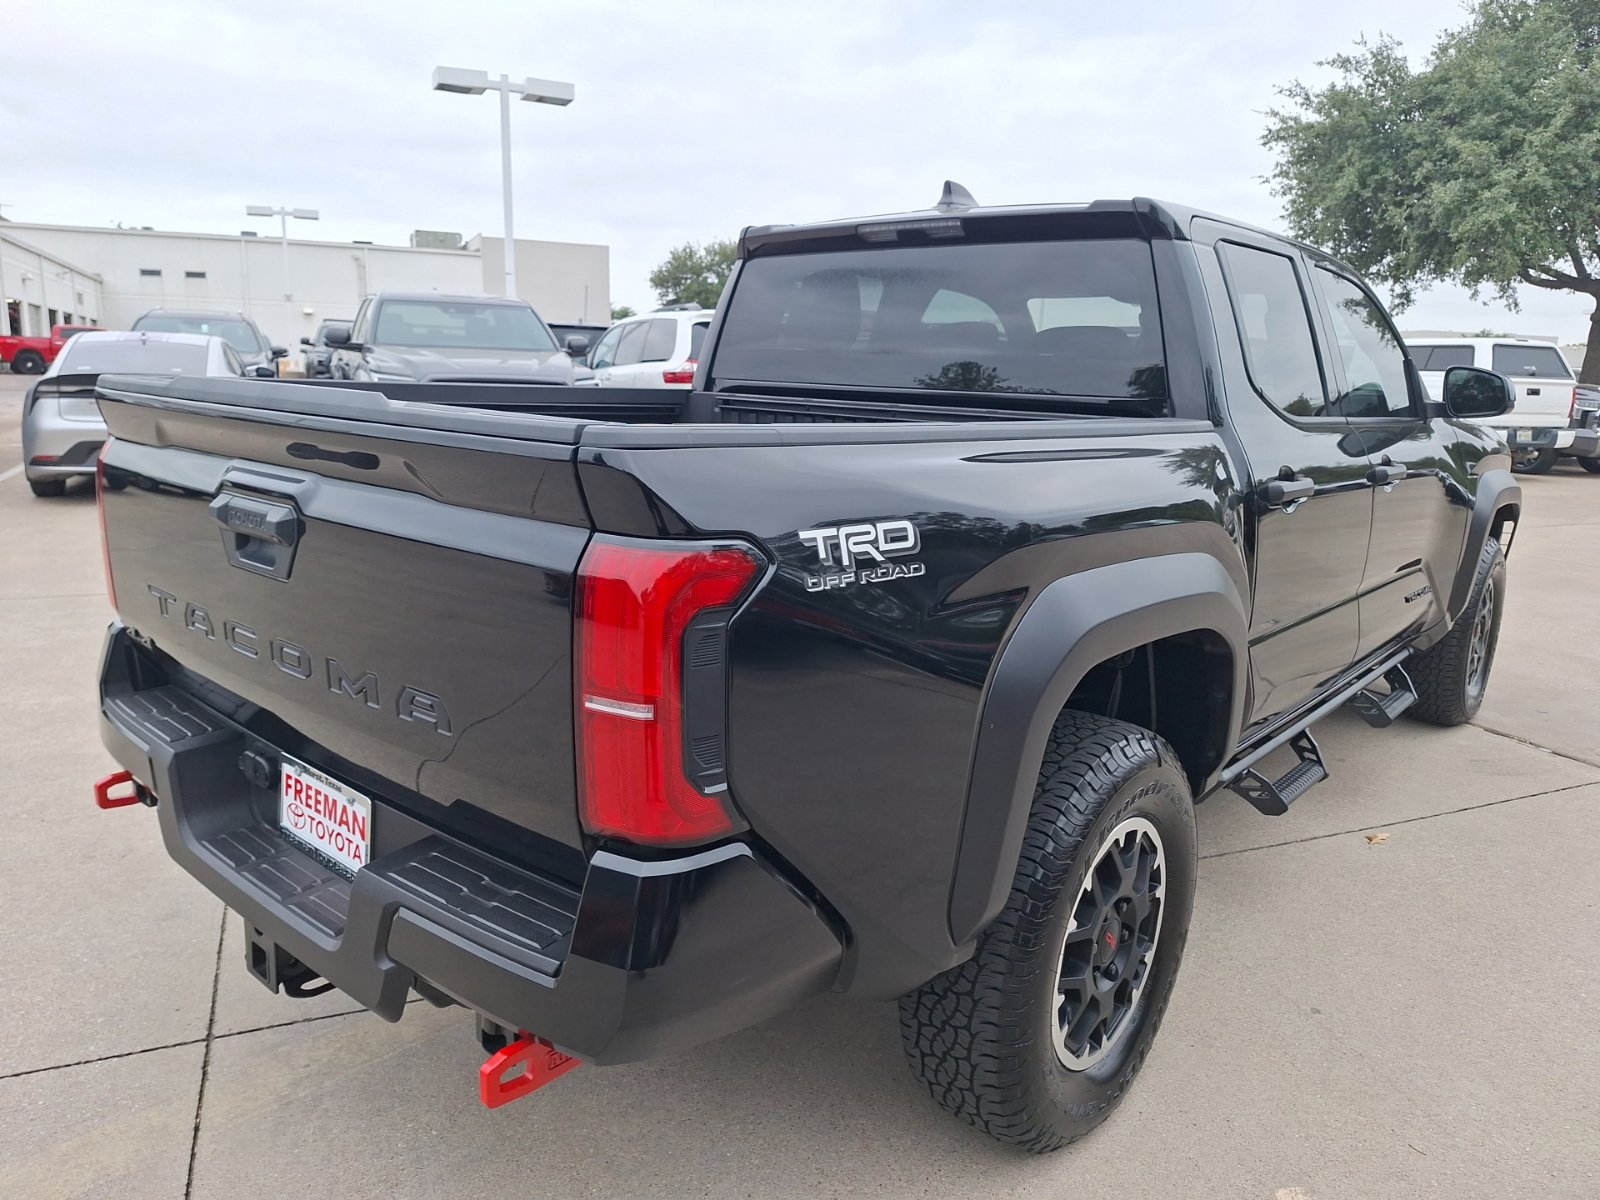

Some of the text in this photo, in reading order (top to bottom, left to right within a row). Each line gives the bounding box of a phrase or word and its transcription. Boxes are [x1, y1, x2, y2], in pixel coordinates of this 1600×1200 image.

[798, 519, 922, 572] TRD
[804, 561, 926, 592] OFF ROAD
[147, 584, 452, 736] TACOMA
[285, 773, 366, 842] FREEMAN
[323, 776, 342, 793] Texas
[308, 815, 363, 865] TOYOTA
